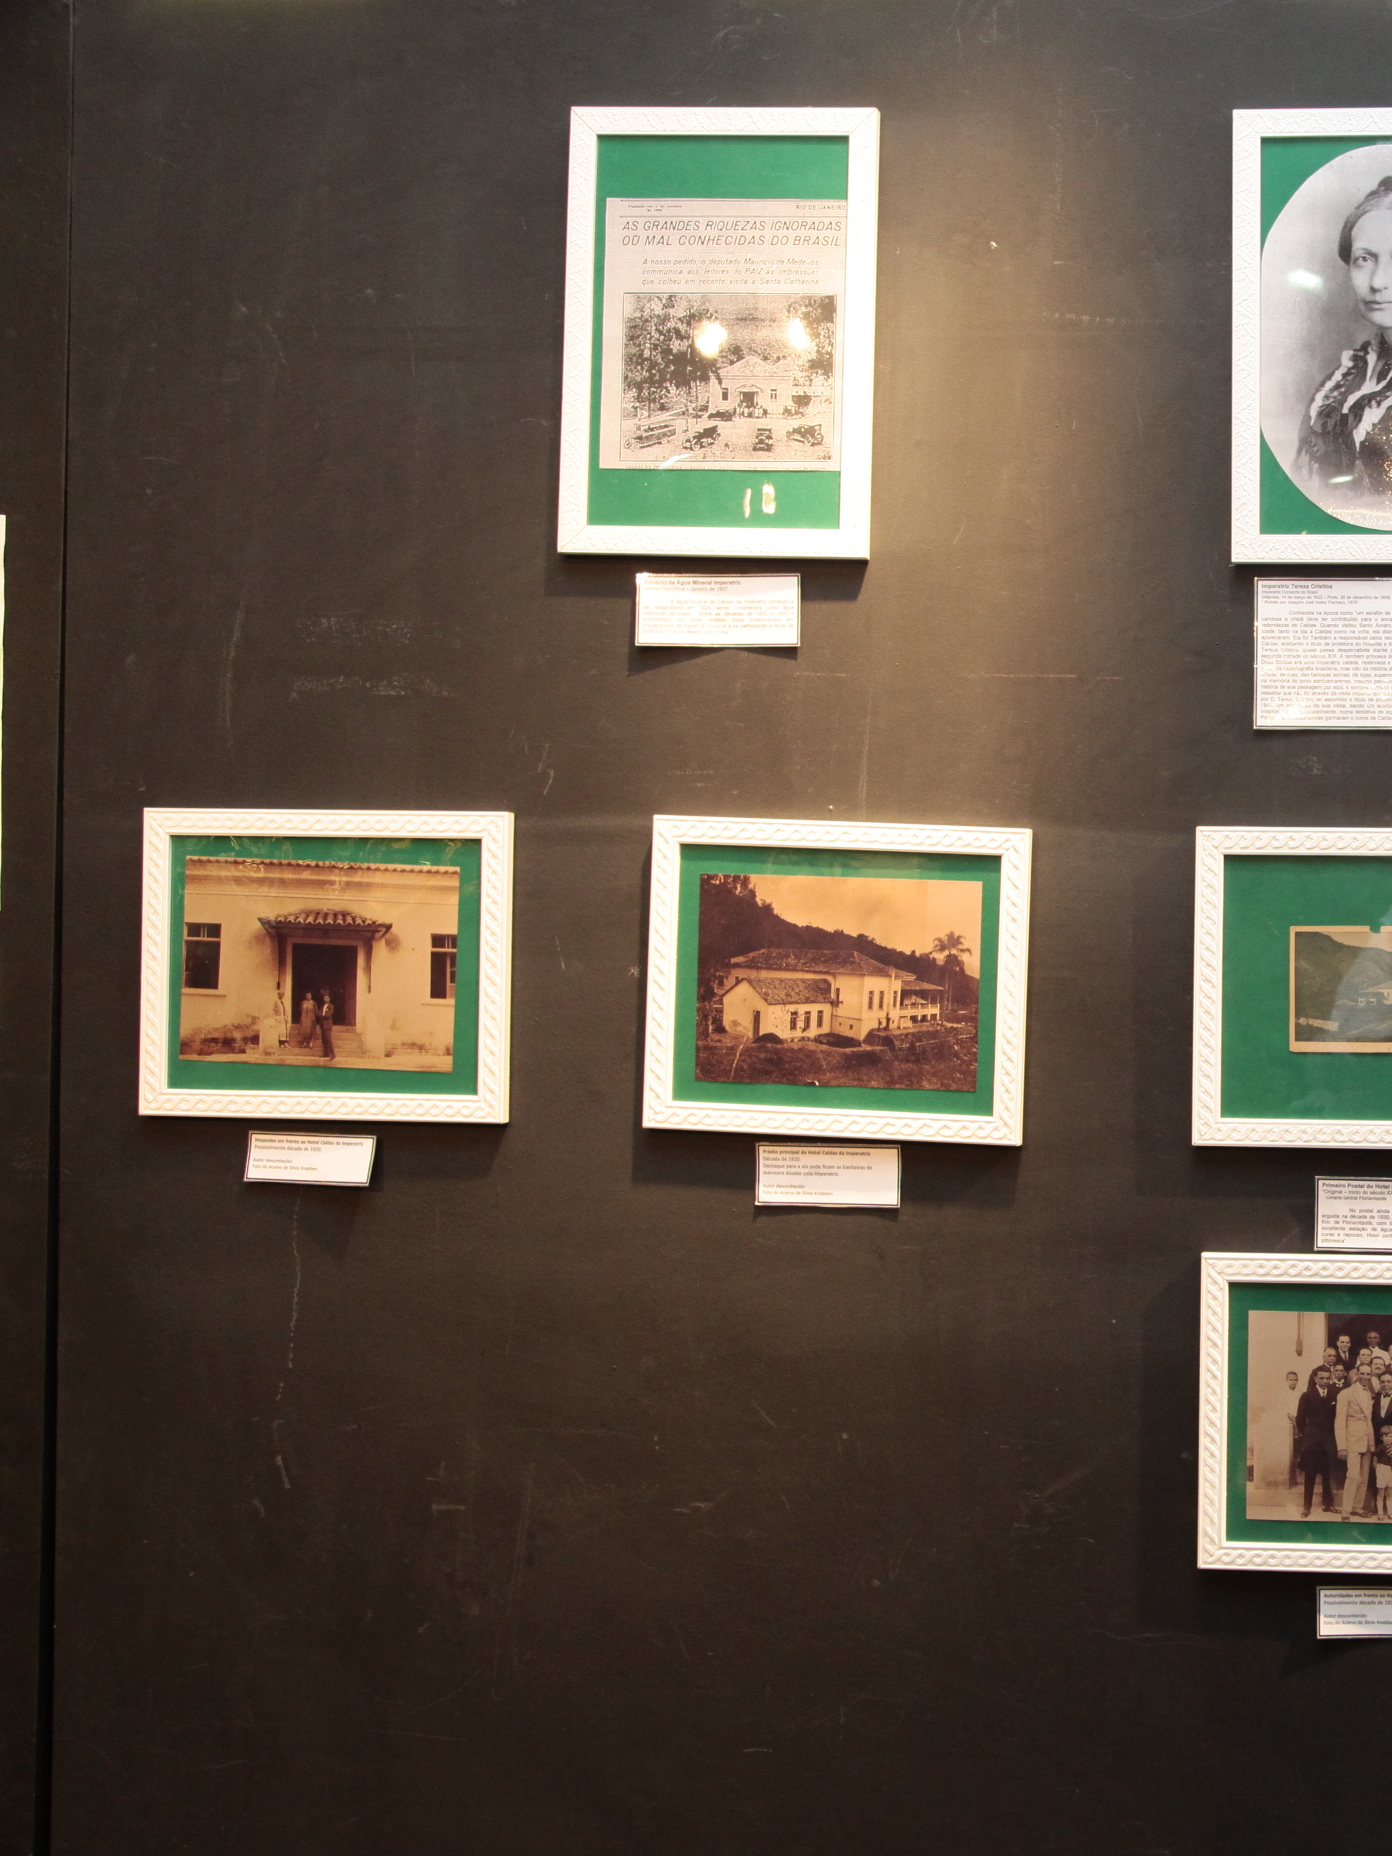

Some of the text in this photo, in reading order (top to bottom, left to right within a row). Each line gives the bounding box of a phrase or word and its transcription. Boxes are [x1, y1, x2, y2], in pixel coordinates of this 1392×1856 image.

[622, 221, 842, 232] AS GRANDES RIQUEZAS IGNORADAS
[645, 236, 672, 246] MAL
[679, 236, 765, 246] CONHECIDAS
[771, 236, 789, 245] DO
[793, 236, 841, 246] BRASIL
[709, 258, 740, 266] deputado
